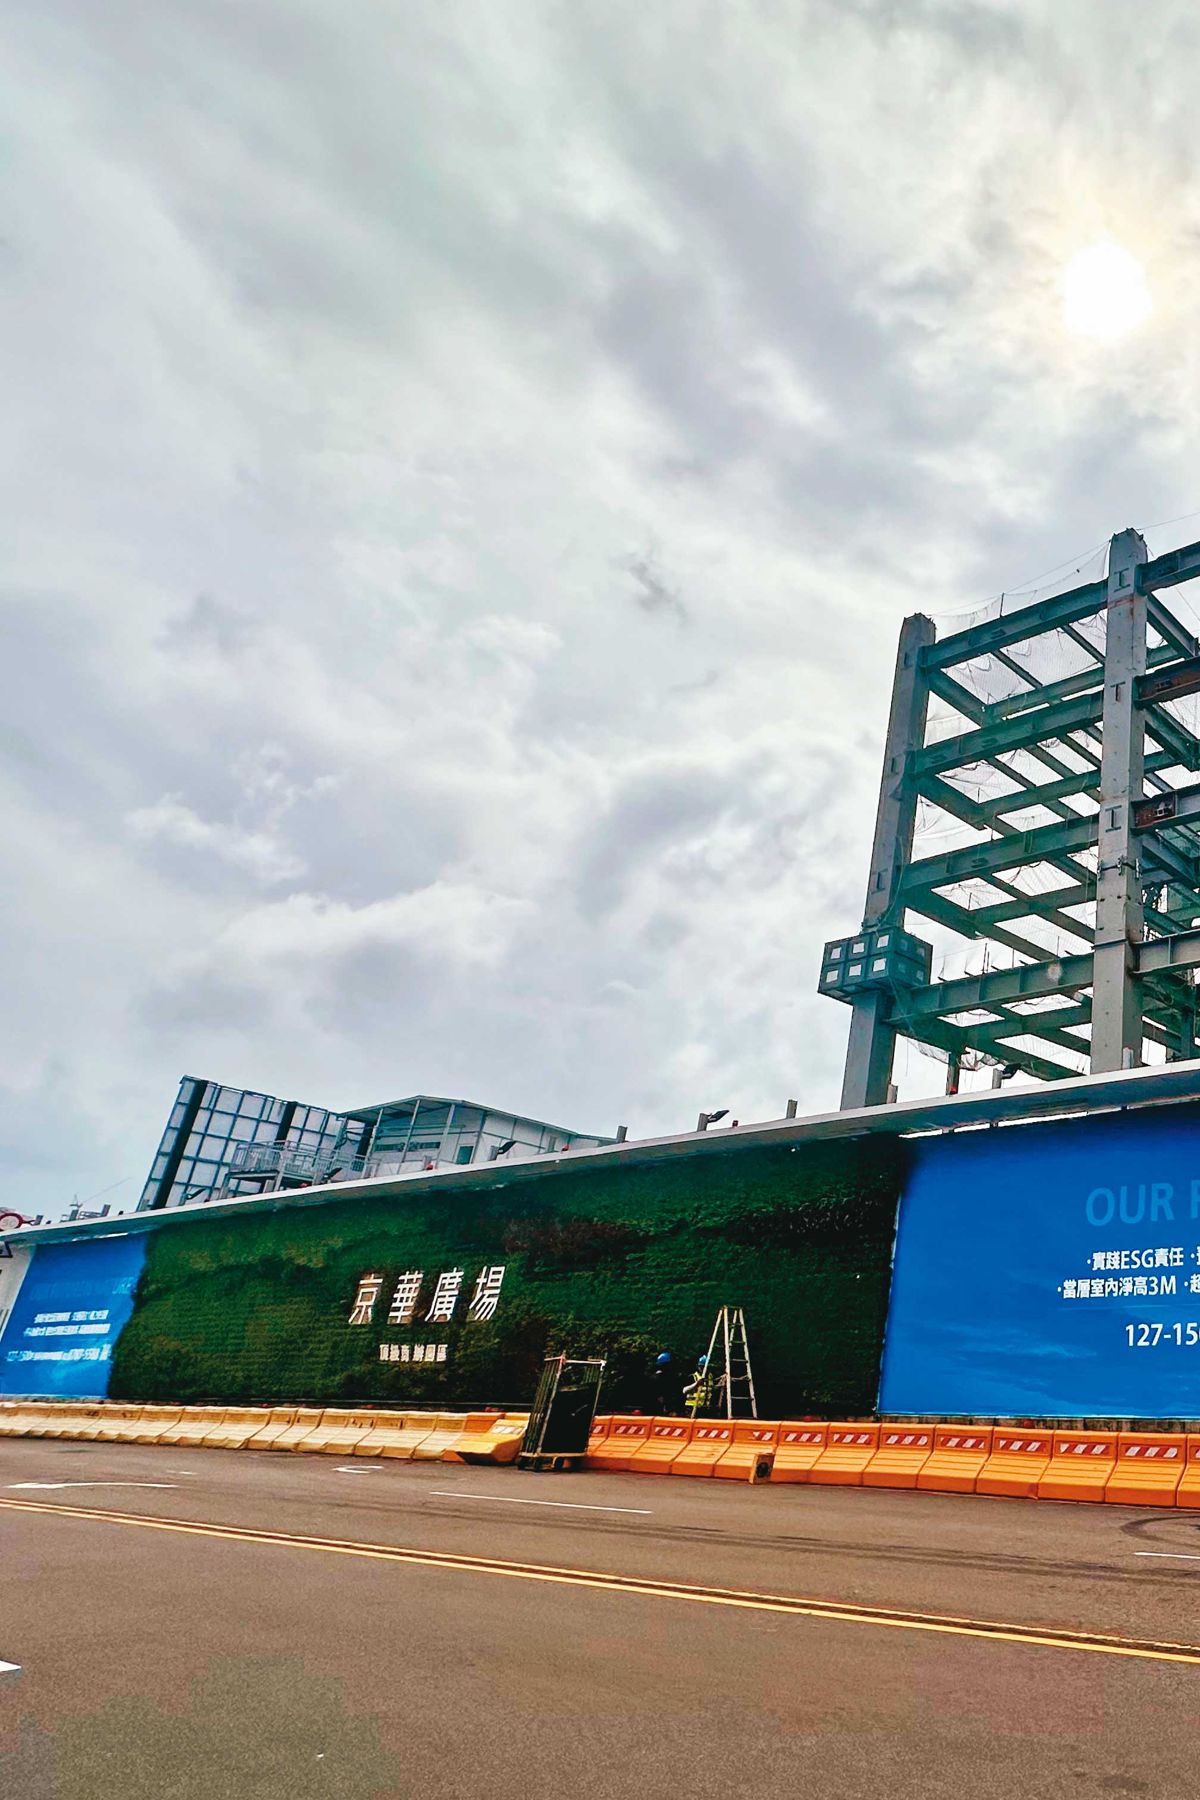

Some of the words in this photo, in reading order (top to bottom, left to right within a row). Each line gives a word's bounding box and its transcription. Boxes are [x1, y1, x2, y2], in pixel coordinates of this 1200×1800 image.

[1086, 1182, 1175, 1226] OUR
[348, 1265, 506, 1325] 京華廣場
